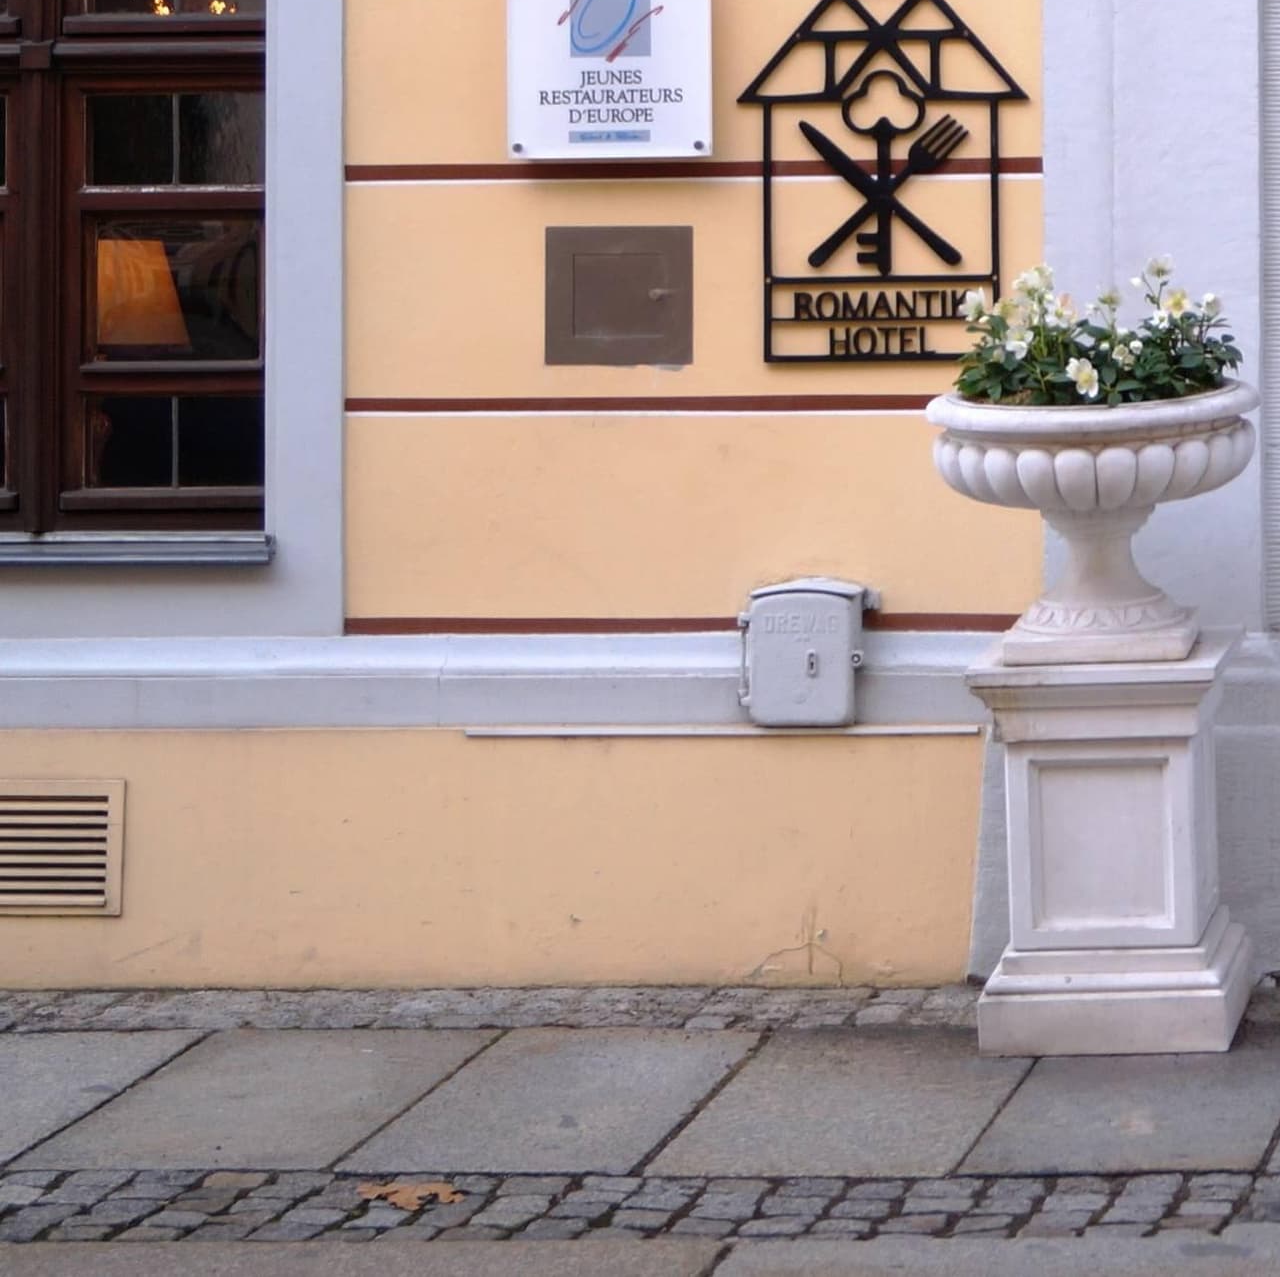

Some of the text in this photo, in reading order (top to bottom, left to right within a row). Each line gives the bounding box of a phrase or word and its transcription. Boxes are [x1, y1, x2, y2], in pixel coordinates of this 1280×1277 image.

[579, 69, 643, 88] JEUNES
[539, 88, 684, 106] RESTAURATEURS
[568, 107, 654, 124] D'EUROPE
[793, 289, 971, 320] ROMANTIK
[829, 326, 937, 355] HOTEL
